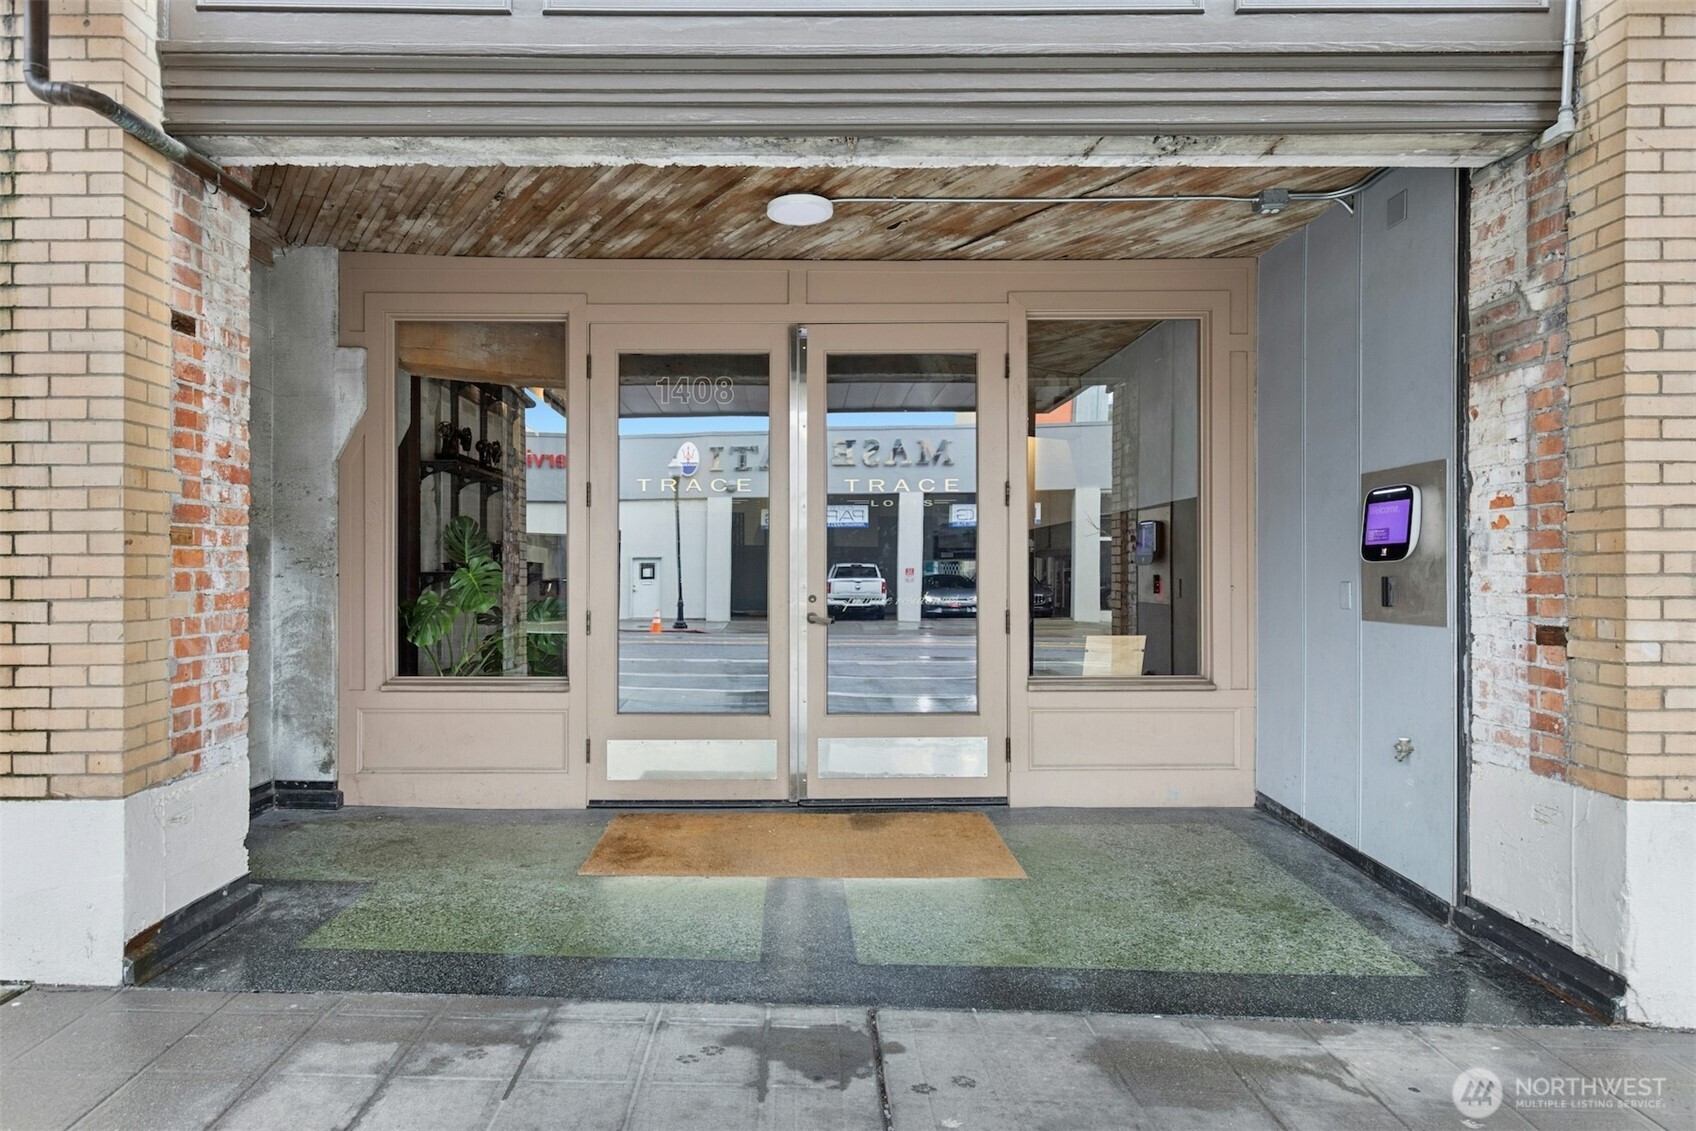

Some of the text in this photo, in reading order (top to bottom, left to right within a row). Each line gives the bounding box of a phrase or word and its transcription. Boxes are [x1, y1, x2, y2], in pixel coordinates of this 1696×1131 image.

[656, 376, 734, 405] 1408
[636, 478, 752, 492] TRACE
[844, 478, 960, 493] TRACE
